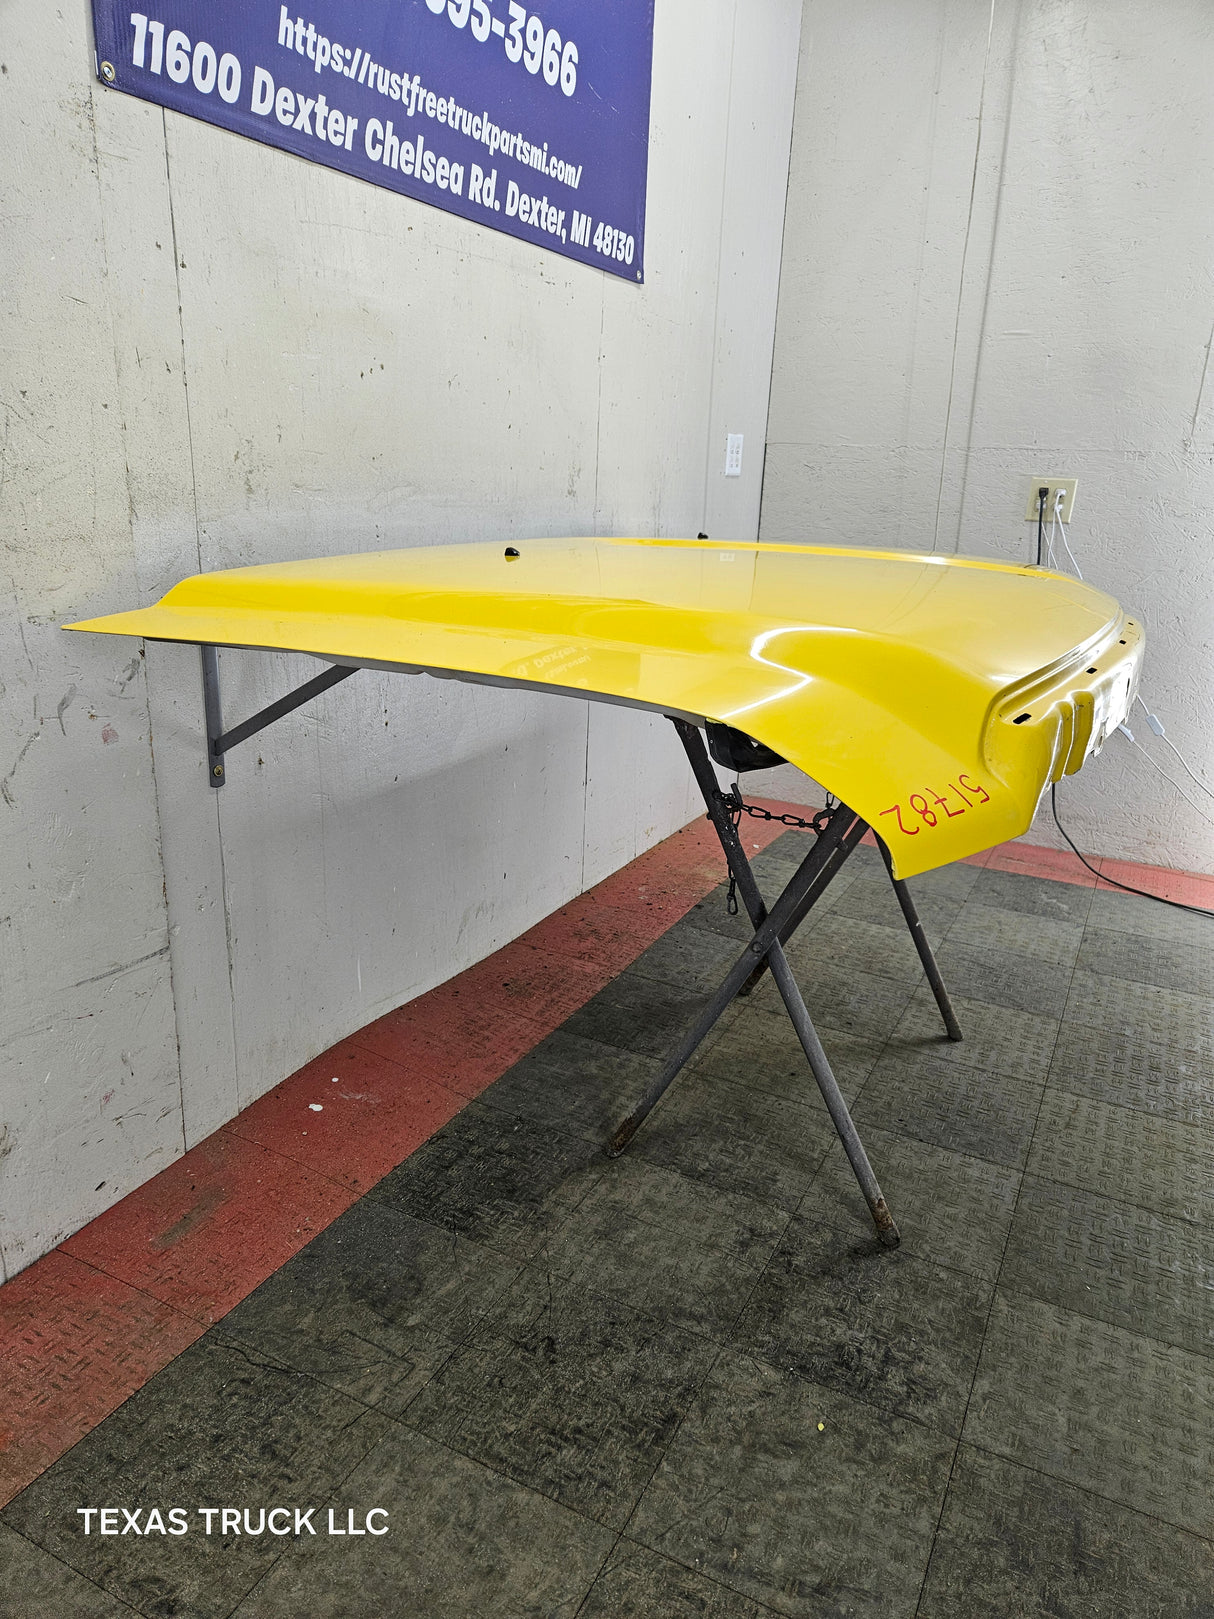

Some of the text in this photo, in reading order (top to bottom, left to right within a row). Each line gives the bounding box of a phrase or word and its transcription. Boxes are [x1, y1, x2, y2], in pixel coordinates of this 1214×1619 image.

[277, 5, 583, 190] https://rustfreetruckpartsmi.com/
[425, 0, 579, 97] 95-3966
[130, 12, 635, 266] 11600 Dexter Chelsea Rd. Dexter, MI 48130
[879, 774, 990, 835] 51782
